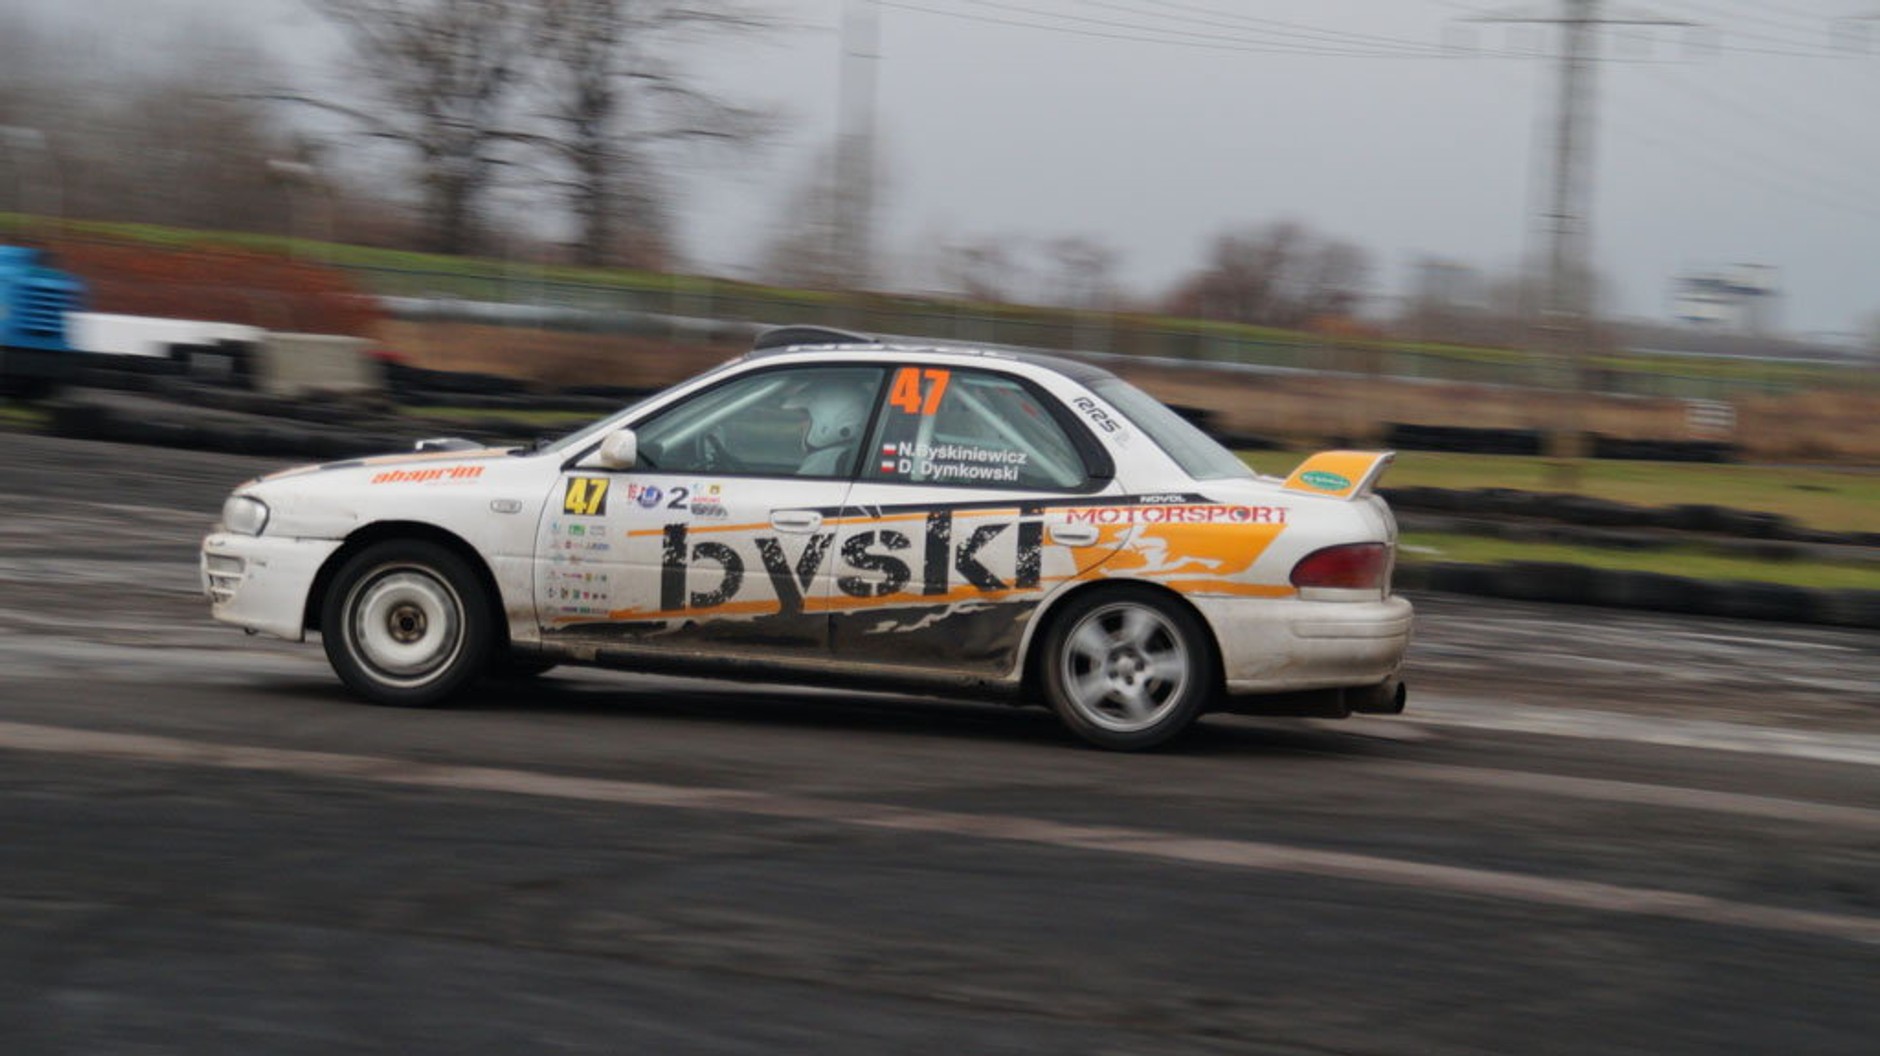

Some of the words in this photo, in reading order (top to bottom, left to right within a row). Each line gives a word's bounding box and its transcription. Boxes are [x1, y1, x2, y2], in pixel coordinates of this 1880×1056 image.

[890, 367, 951, 416] 47
[1073, 396, 1122, 433] RRS
[898, 458, 916, 475] D.
[920, 460, 1019, 481] Dymkowski
[564, 477, 610, 516] 47
[667, 486, 690, 510] 2
[1065, 505, 1291, 526] MOTORSPORT
